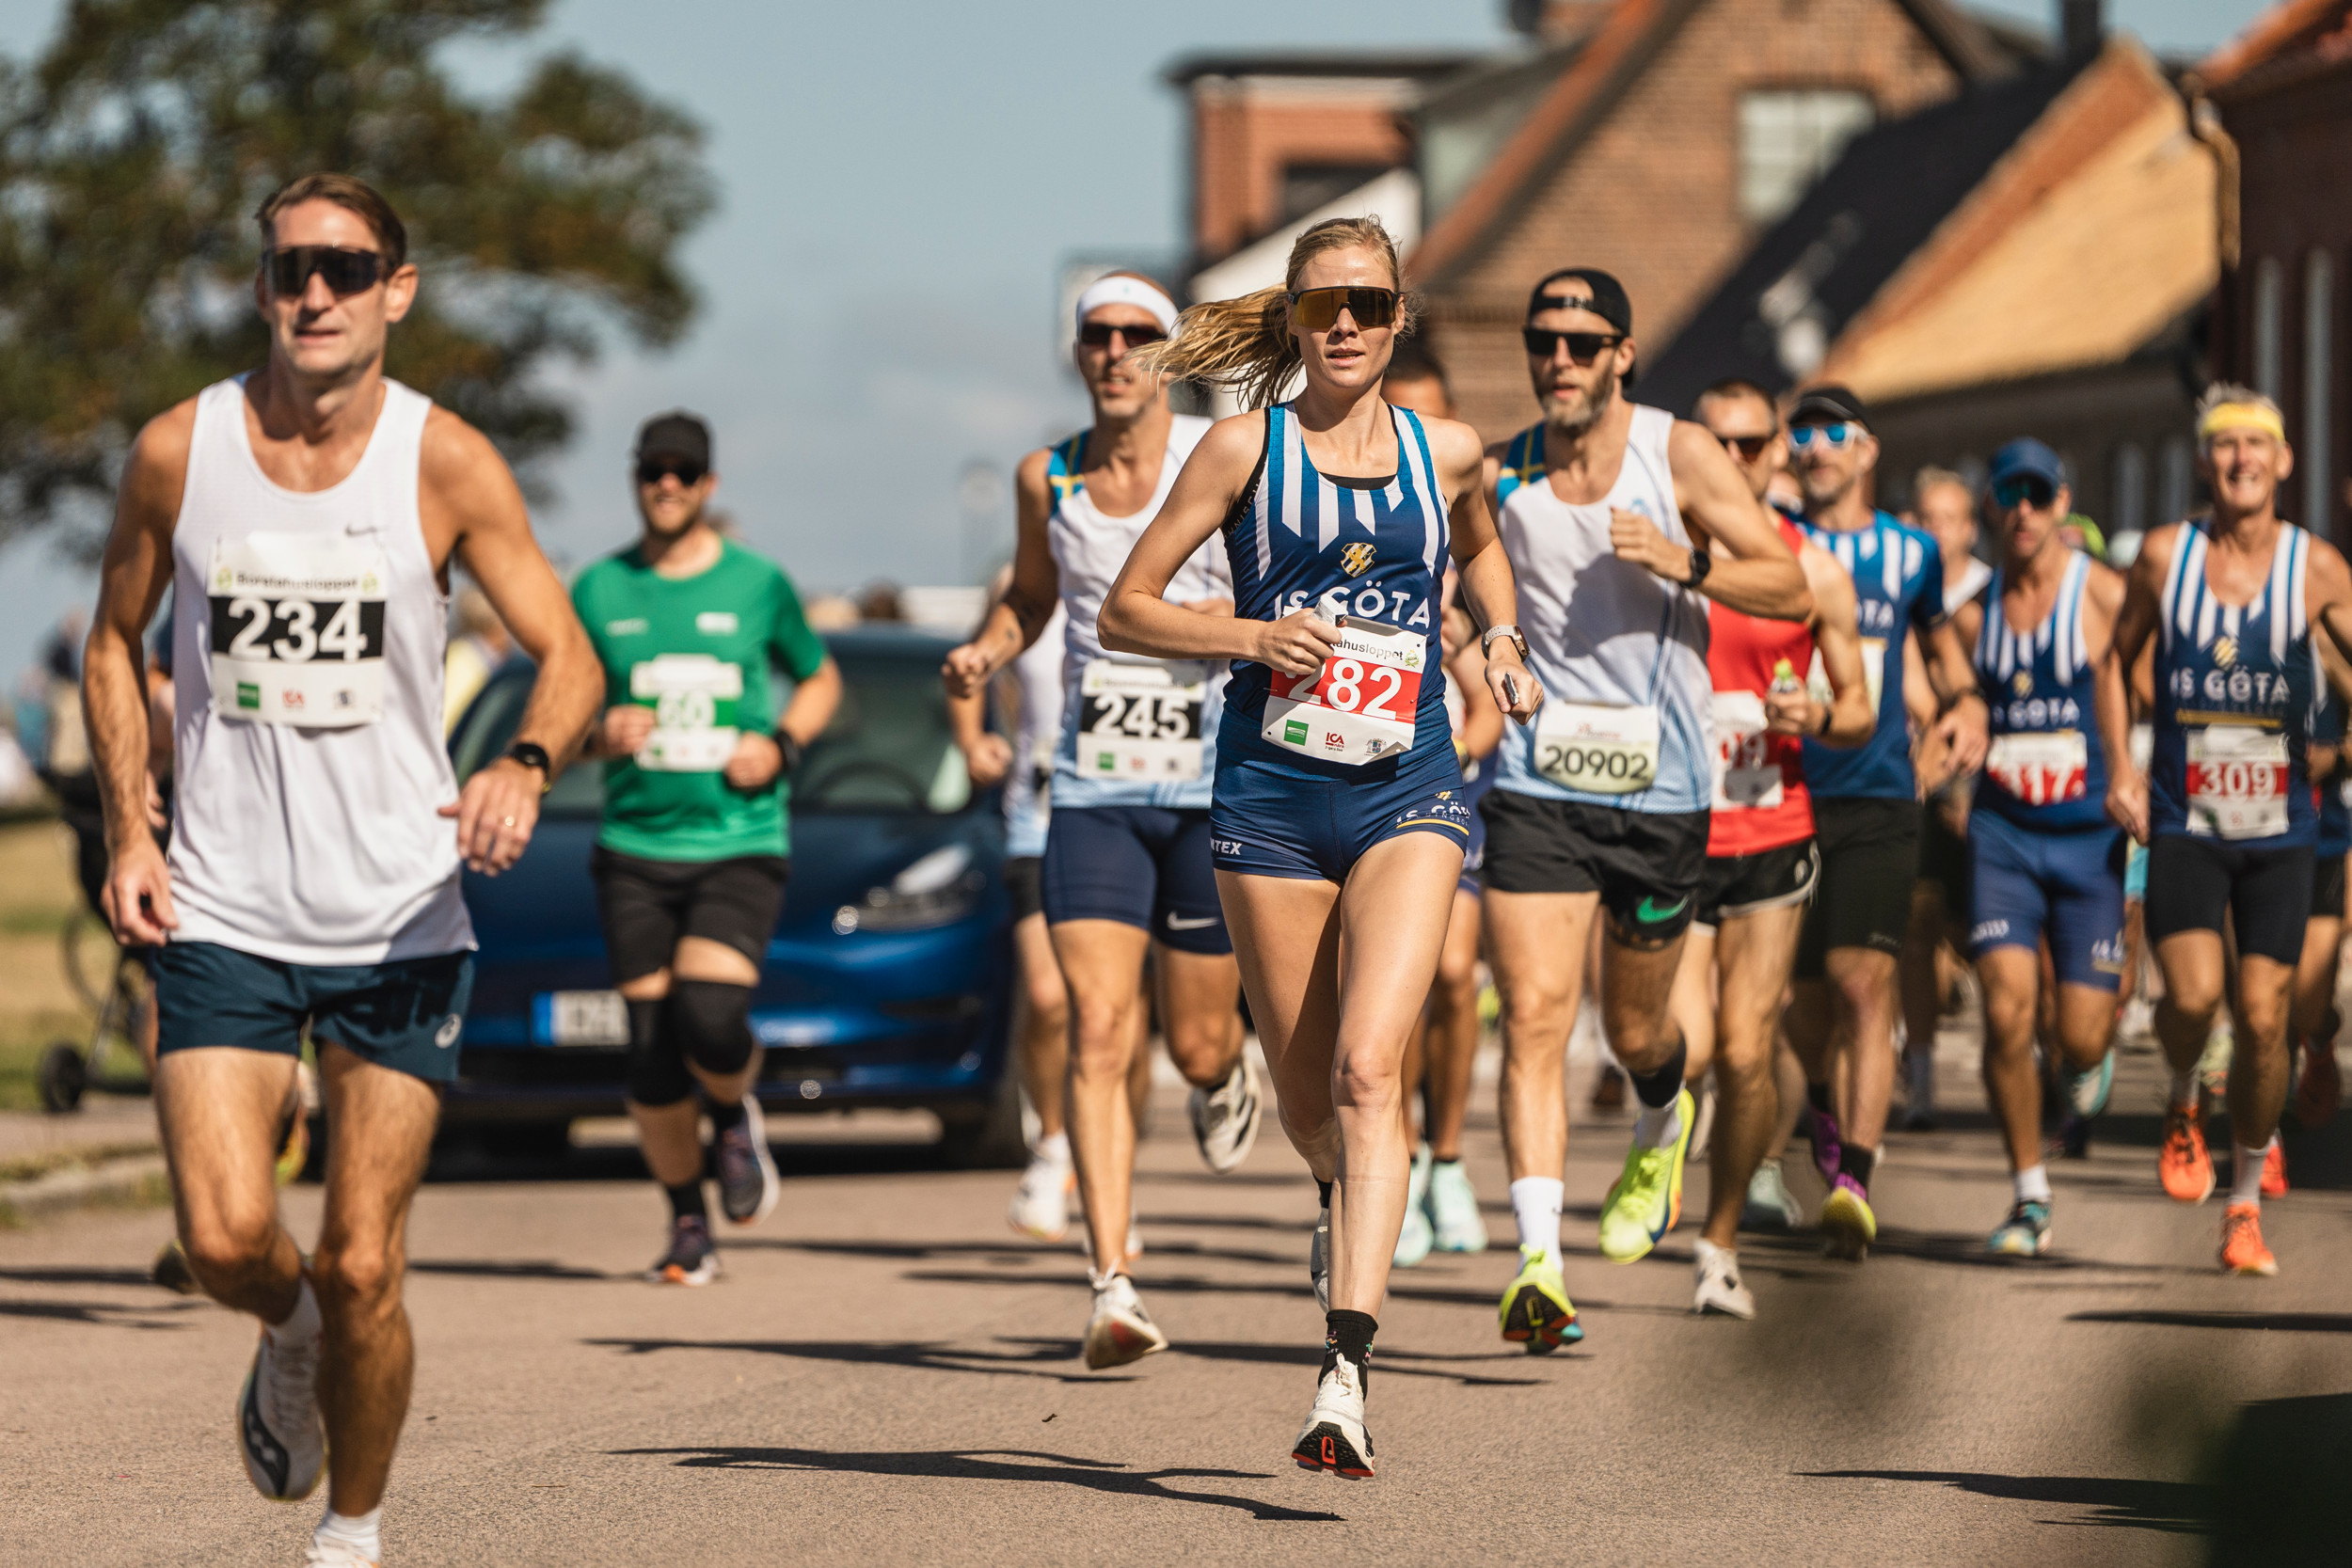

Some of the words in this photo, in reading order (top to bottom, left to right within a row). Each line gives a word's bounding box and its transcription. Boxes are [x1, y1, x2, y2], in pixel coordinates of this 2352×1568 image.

[228, 596, 368, 663] 234
[1332, 639, 1404, 660] ahusloppet
[1286, 658, 1402, 721] 282
[1091, 691, 1190, 740] 245
[1326, 732, 1344, 744] ICA
[1544, 746, 1649, 781] 20902
[2199, 763, 2277, 800] 309
